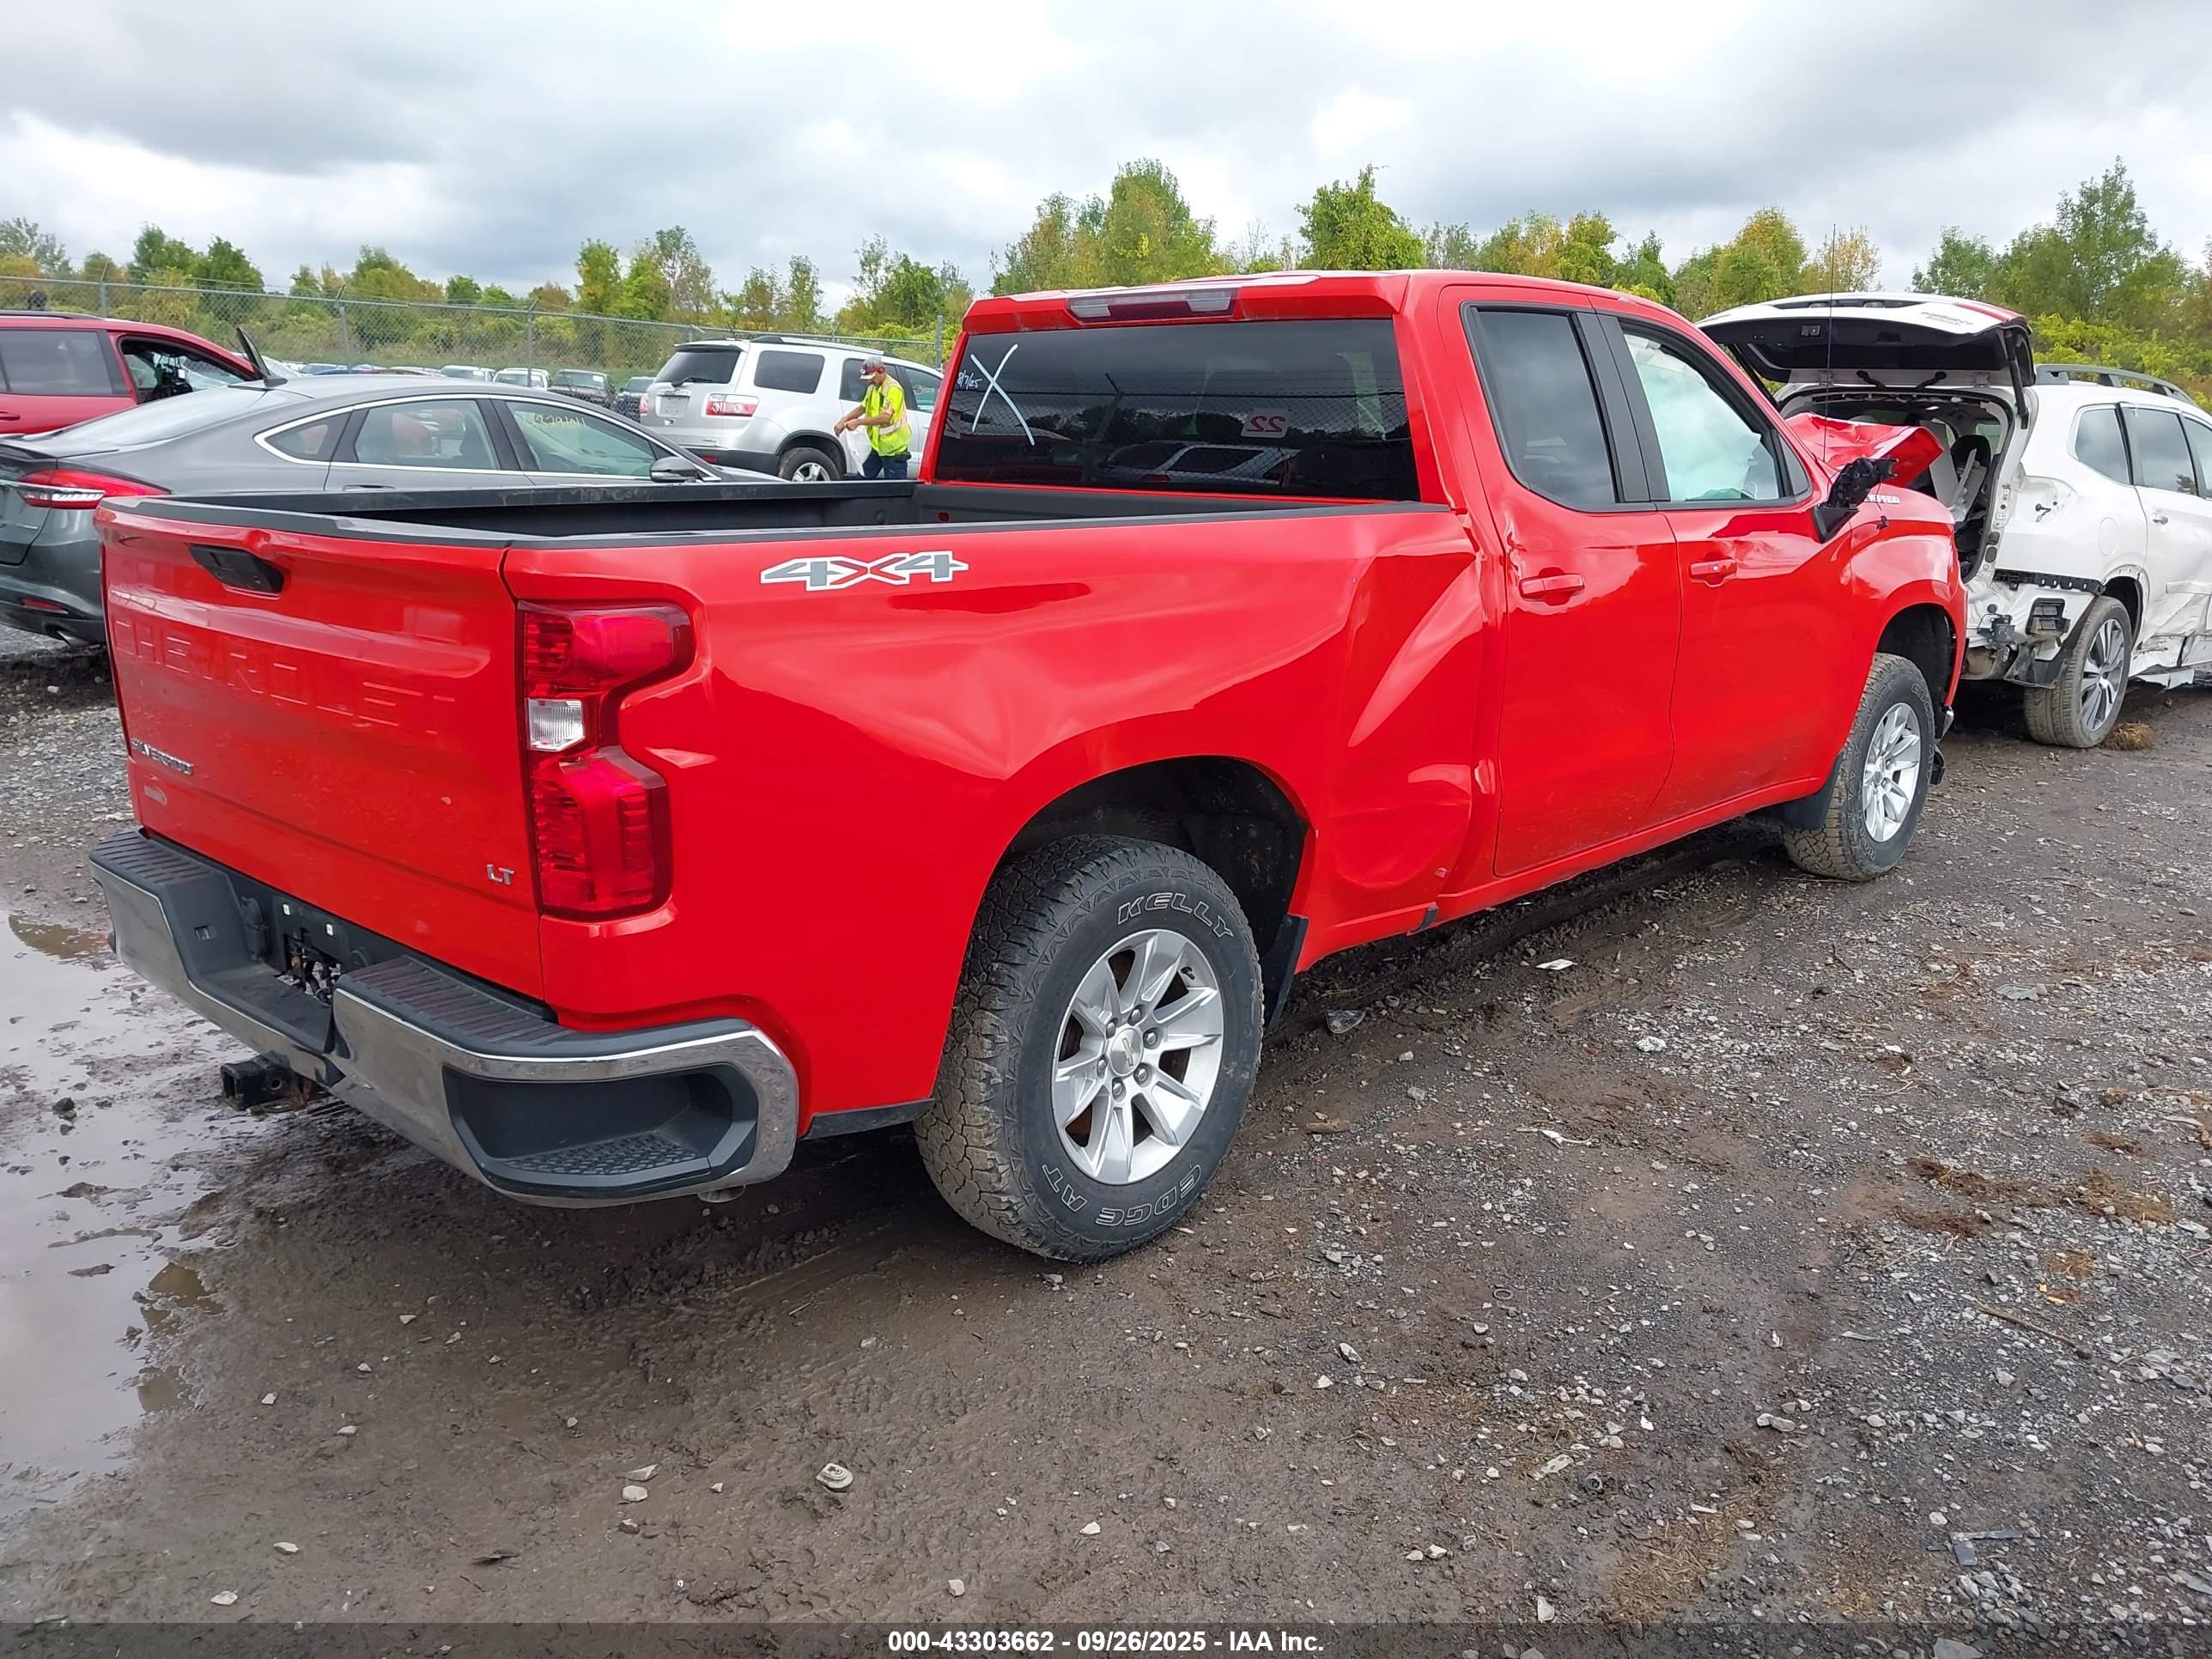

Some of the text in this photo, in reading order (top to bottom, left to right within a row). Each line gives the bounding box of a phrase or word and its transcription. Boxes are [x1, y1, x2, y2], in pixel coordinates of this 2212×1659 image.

[970, 343, 1036, 446] X
[486, 863, 515, 886] LT
[1118, 892, 1234, 938] KELLY
[1042, 1164, 1202, 1226] EDGE AT
